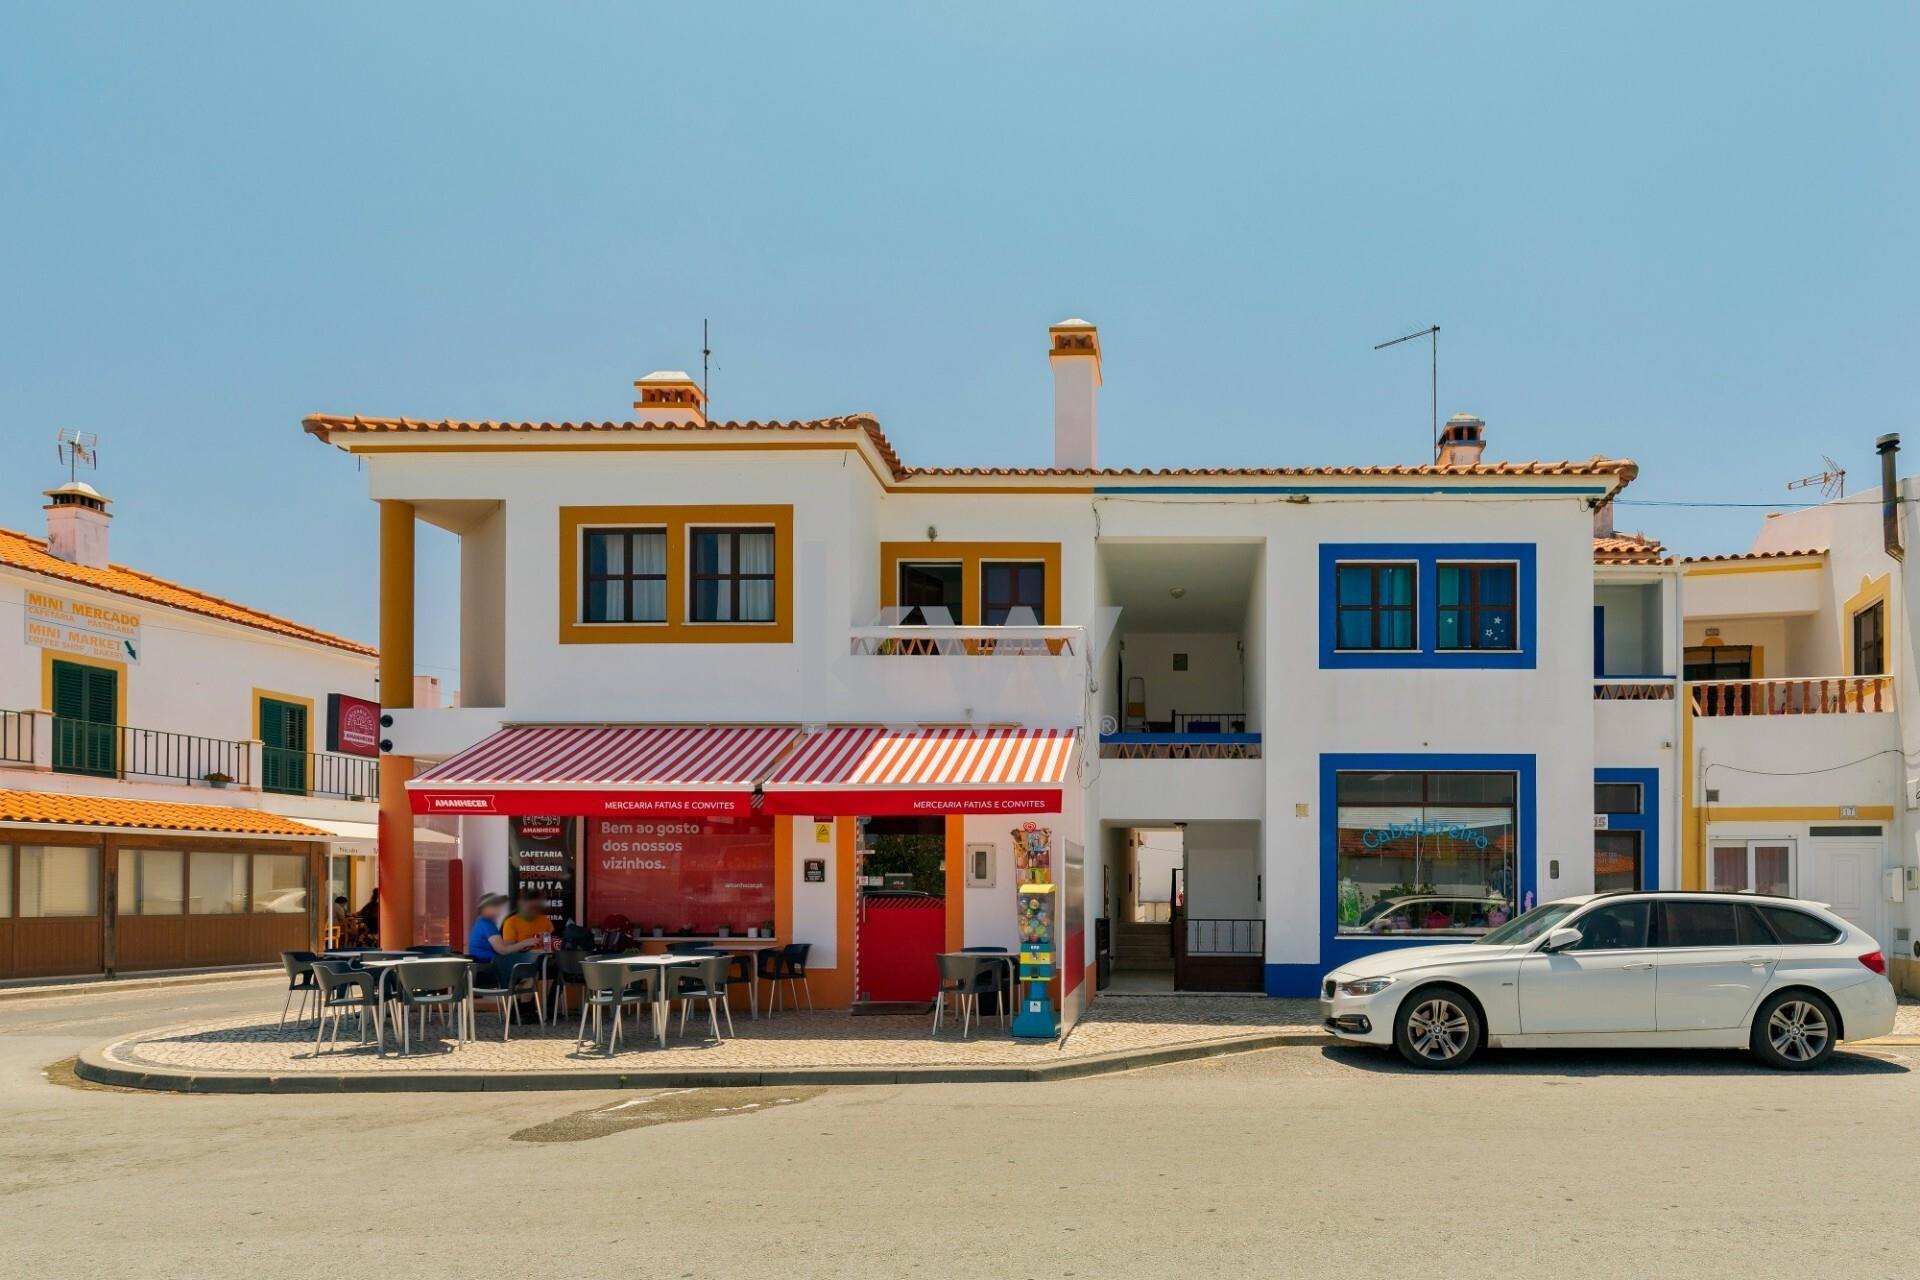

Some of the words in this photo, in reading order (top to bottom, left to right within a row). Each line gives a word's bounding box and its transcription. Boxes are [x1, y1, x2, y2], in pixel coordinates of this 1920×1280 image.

[28, 592, 64, 610] MINI
[72, 603, 140, 627] MERCADO
[28, 623, 61, 639] MINI
[68, 631, 122, 650] MARKET
[435, 799, 488, 807] AMANHECER
[604, 801, 653, 810] MERCEARIA
[654, 801, 683, 809] FATIAS
[684, 801, 690, 809] E
[691, 801, 735, 810] CONVITES
[913, 801, 962, 809] MERCEARIA
[963, 801, 992, 809] FATIAS
[1001, 800, 1046, 808] CONVITES
[601, 821, 633, 833] Bem
[636, 824, 654, 834] ao
[656, 823, 700, 837] gosto
[602, 840, 629, 851] dos
[631, 841, 683, 851] nossos
[520, 850, 563, 858] CAFETARIA
[602, 856, 666, 869] vizinhos.
[519, 881, 563, 890] FRUTA
